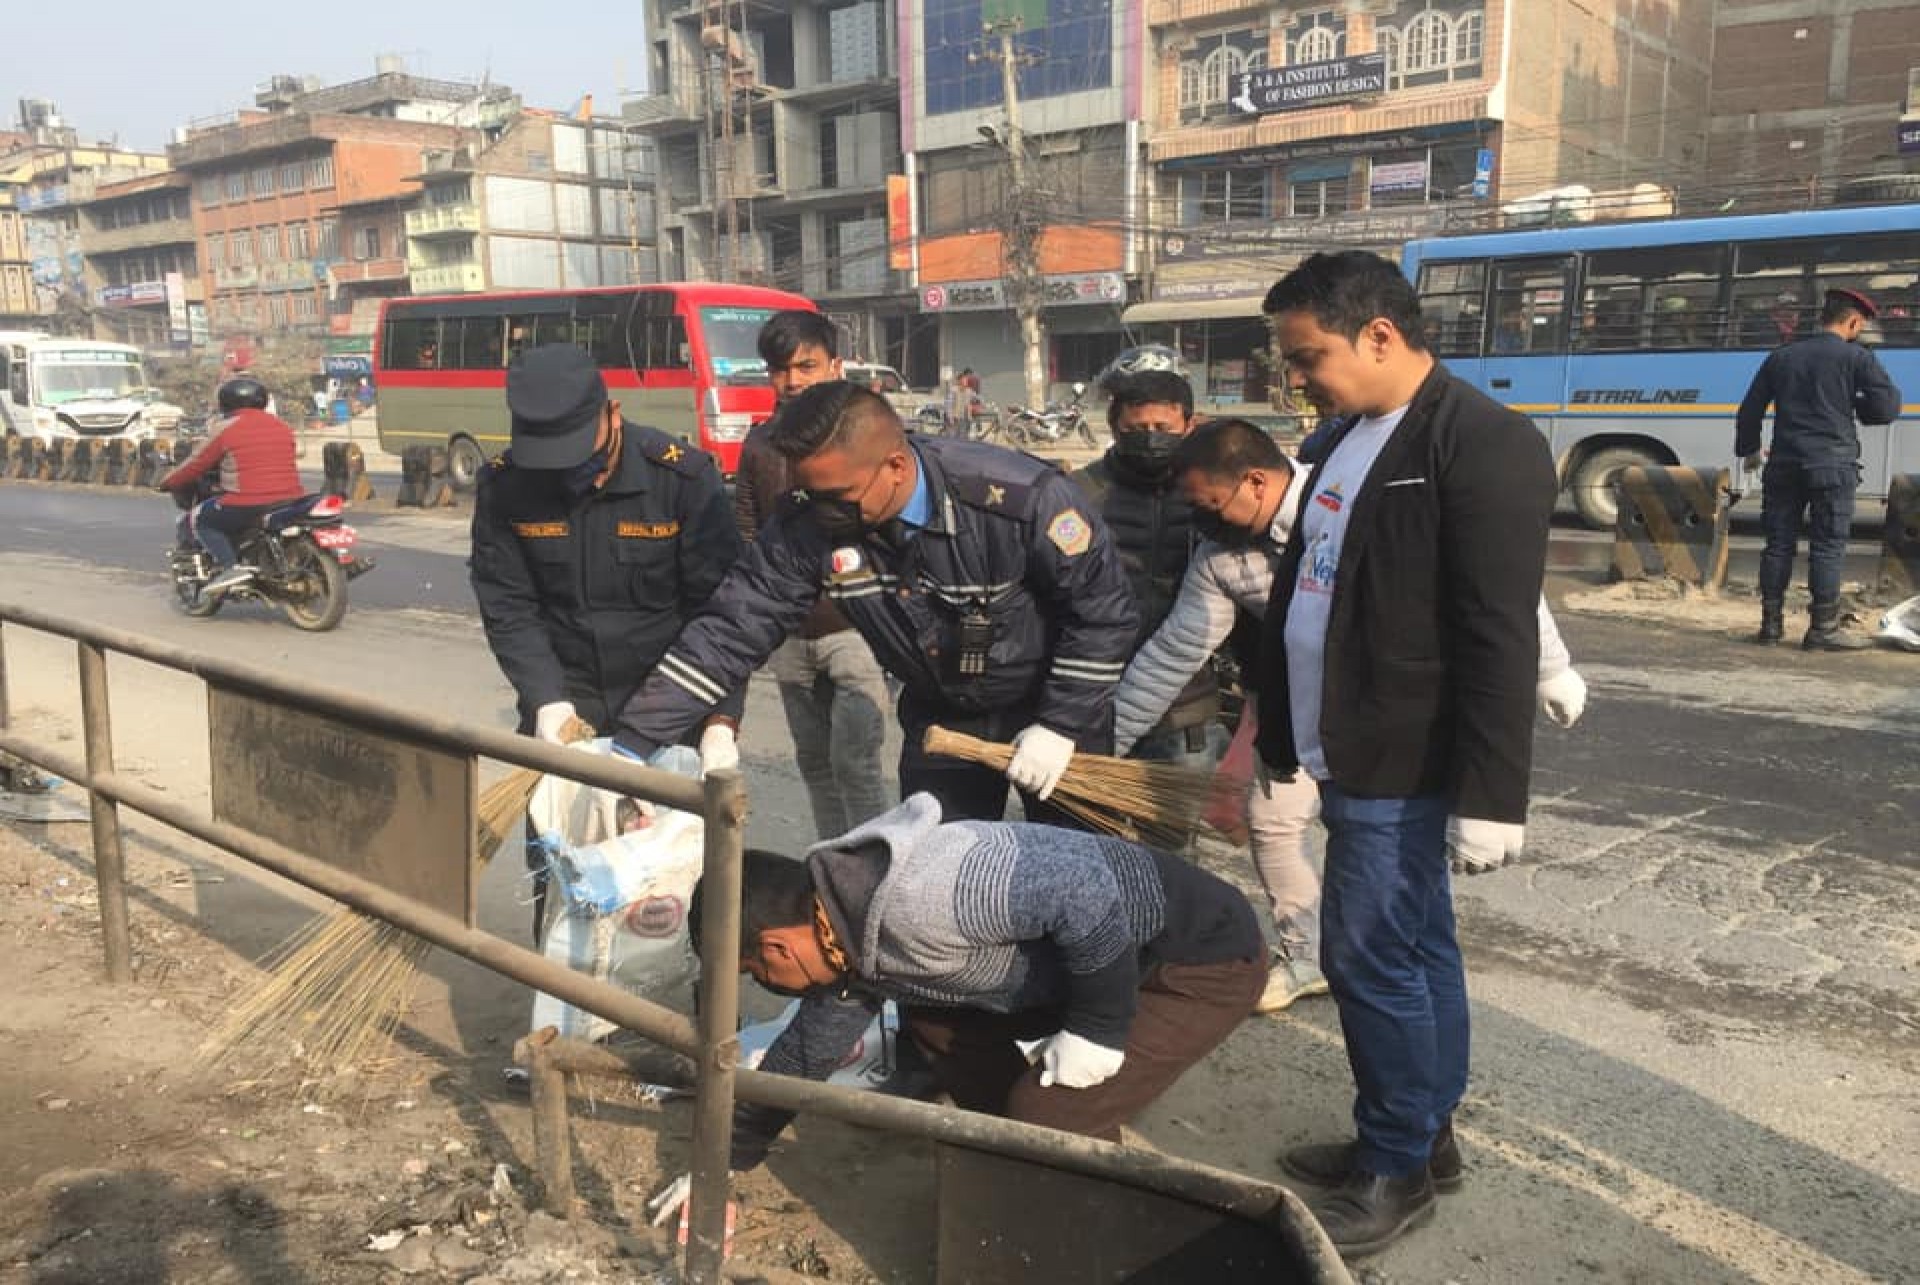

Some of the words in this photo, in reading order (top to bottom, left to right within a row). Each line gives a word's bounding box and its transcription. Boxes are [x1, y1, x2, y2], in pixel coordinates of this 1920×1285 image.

[1286, 62, 1348, 83] INSTITUTE
[1265, 89, 1279, 102] OF
[1283, 83, 1333, 100] FASHION
[1336, 76, 1381, 93] DESIGN
[1570, 388, 1699, 404] STARLINE
